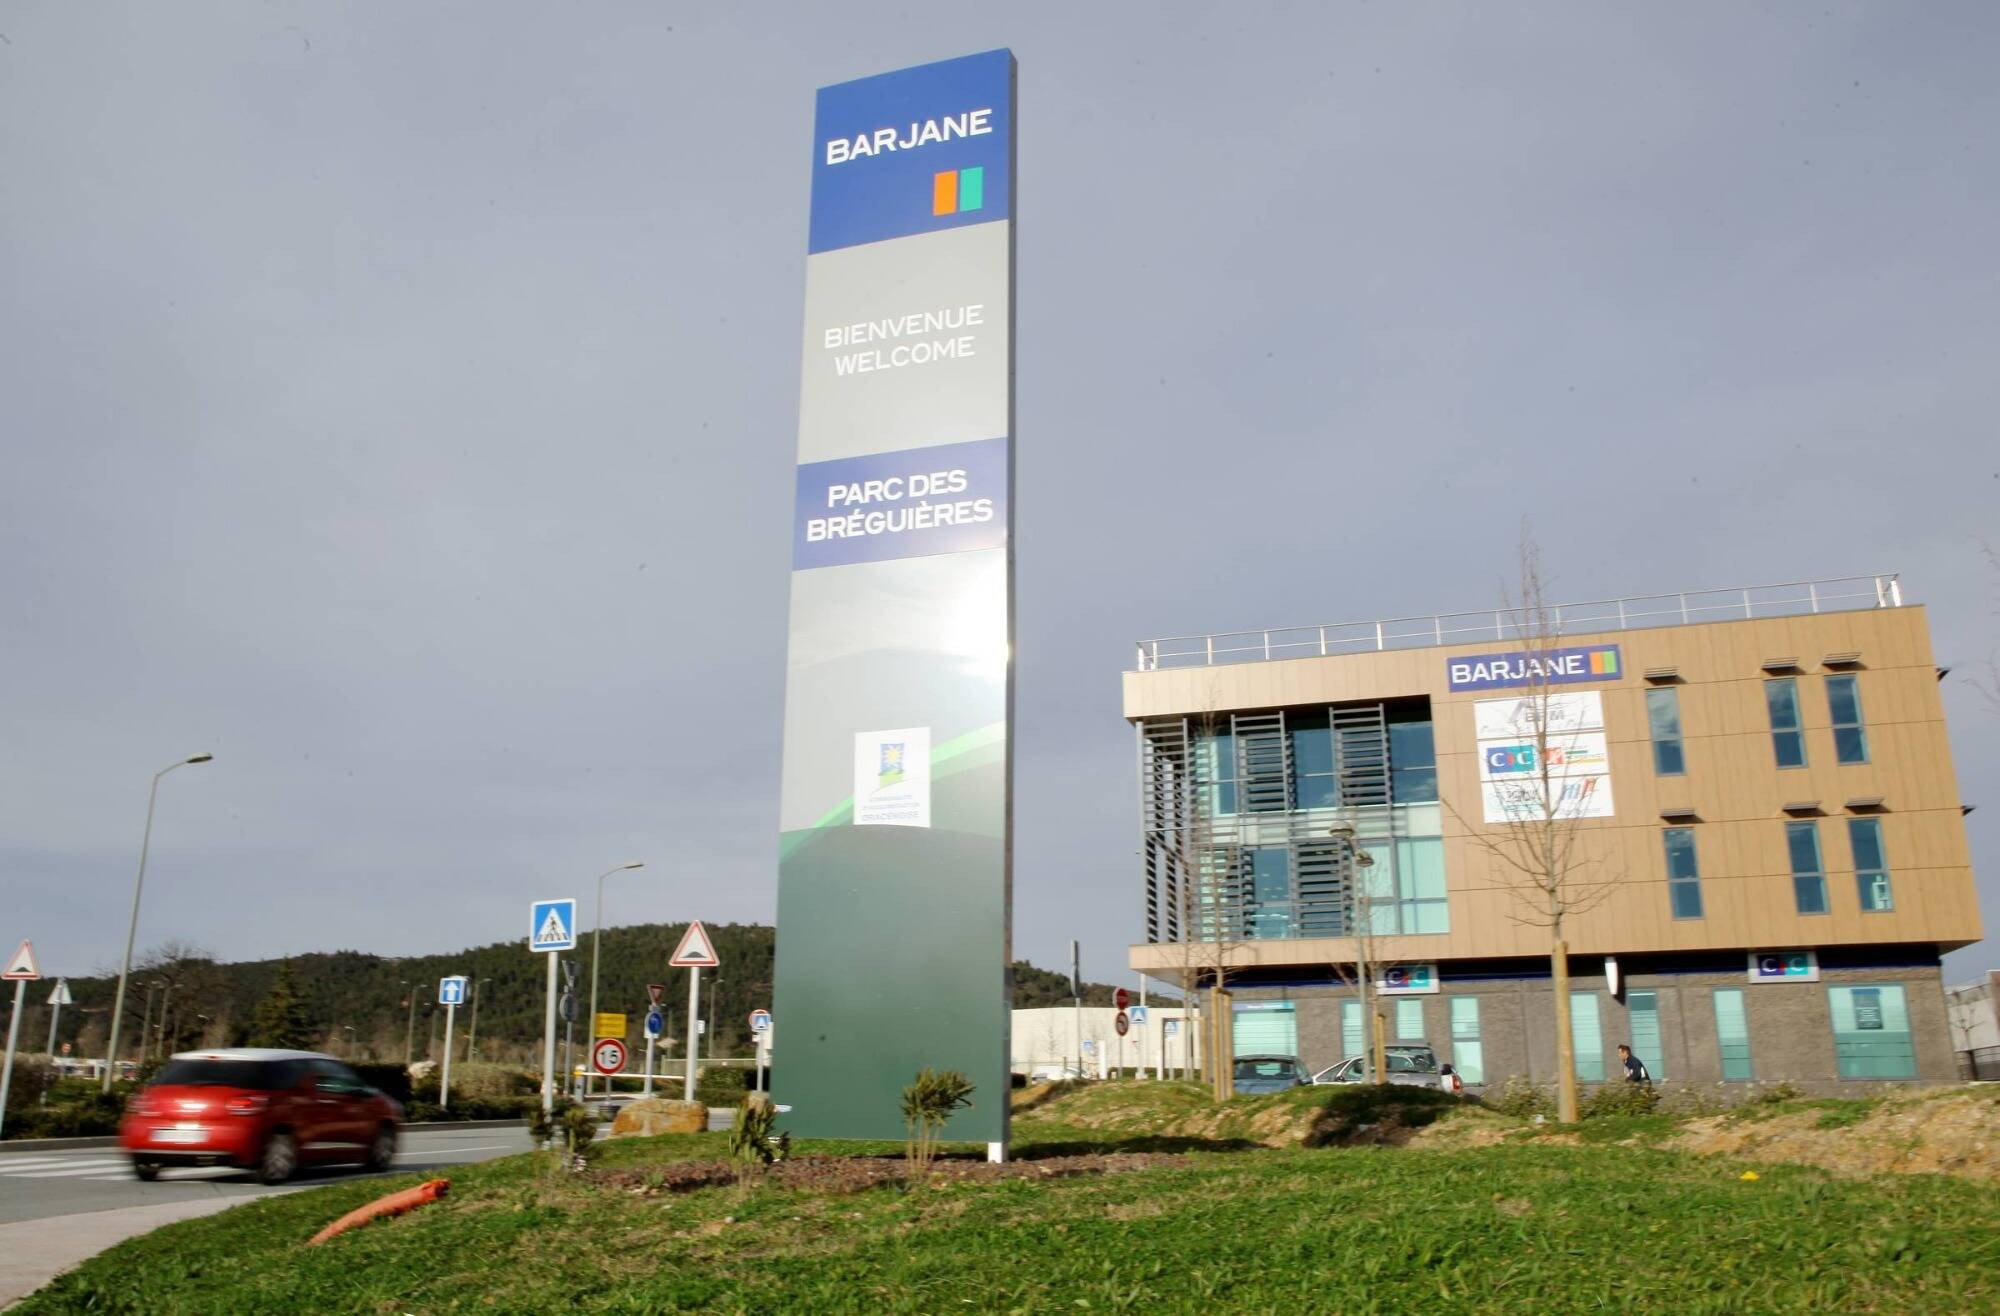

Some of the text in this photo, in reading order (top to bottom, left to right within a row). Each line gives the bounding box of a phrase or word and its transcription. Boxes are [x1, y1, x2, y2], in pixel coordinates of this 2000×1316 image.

[826, 108, 993, 165] BARJANE
[824, 304, 984, 349] BIENVENUE
[834, 335, 976, 376] WELCOME
[828, 469, 968, 508] PARC DES
[806, 498, 994, 542] BRÉGUIÈRES
[1451, 654, 1586, 684] BARJANE
[1490, 751, 1533, 767] CIC
[600, 1049, 618, 1065] 15
